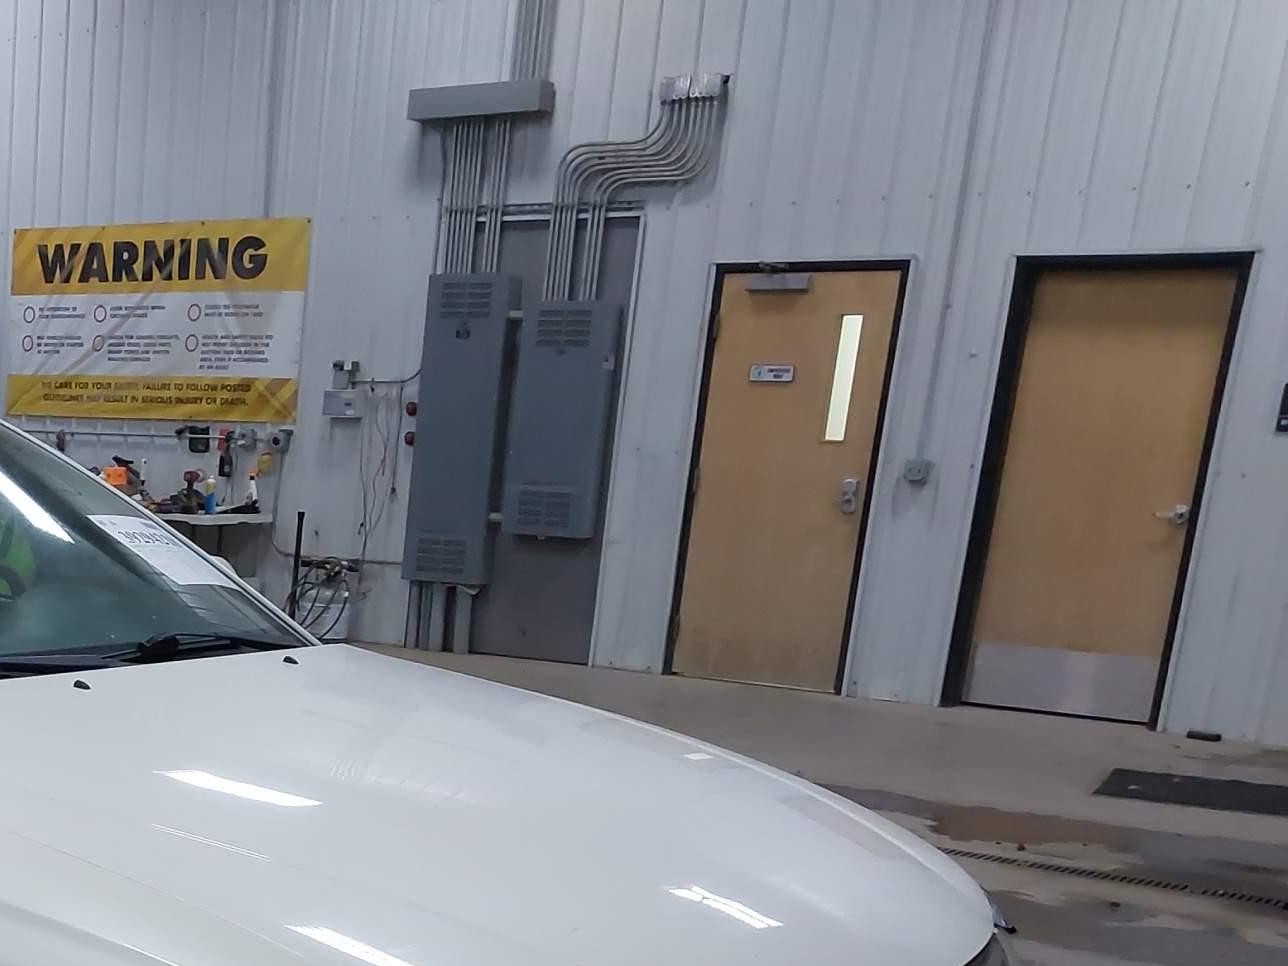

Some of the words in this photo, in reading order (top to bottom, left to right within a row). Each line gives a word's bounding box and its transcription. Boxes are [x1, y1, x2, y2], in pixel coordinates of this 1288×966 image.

[37, 235, 268, 284] WARNING
[74, 382, 89, 390] FOR
[92, 382, 112, 390] YOUR
[174, 383, 184, 391] TO
[186, 383, 218, 392] FOLLOW
